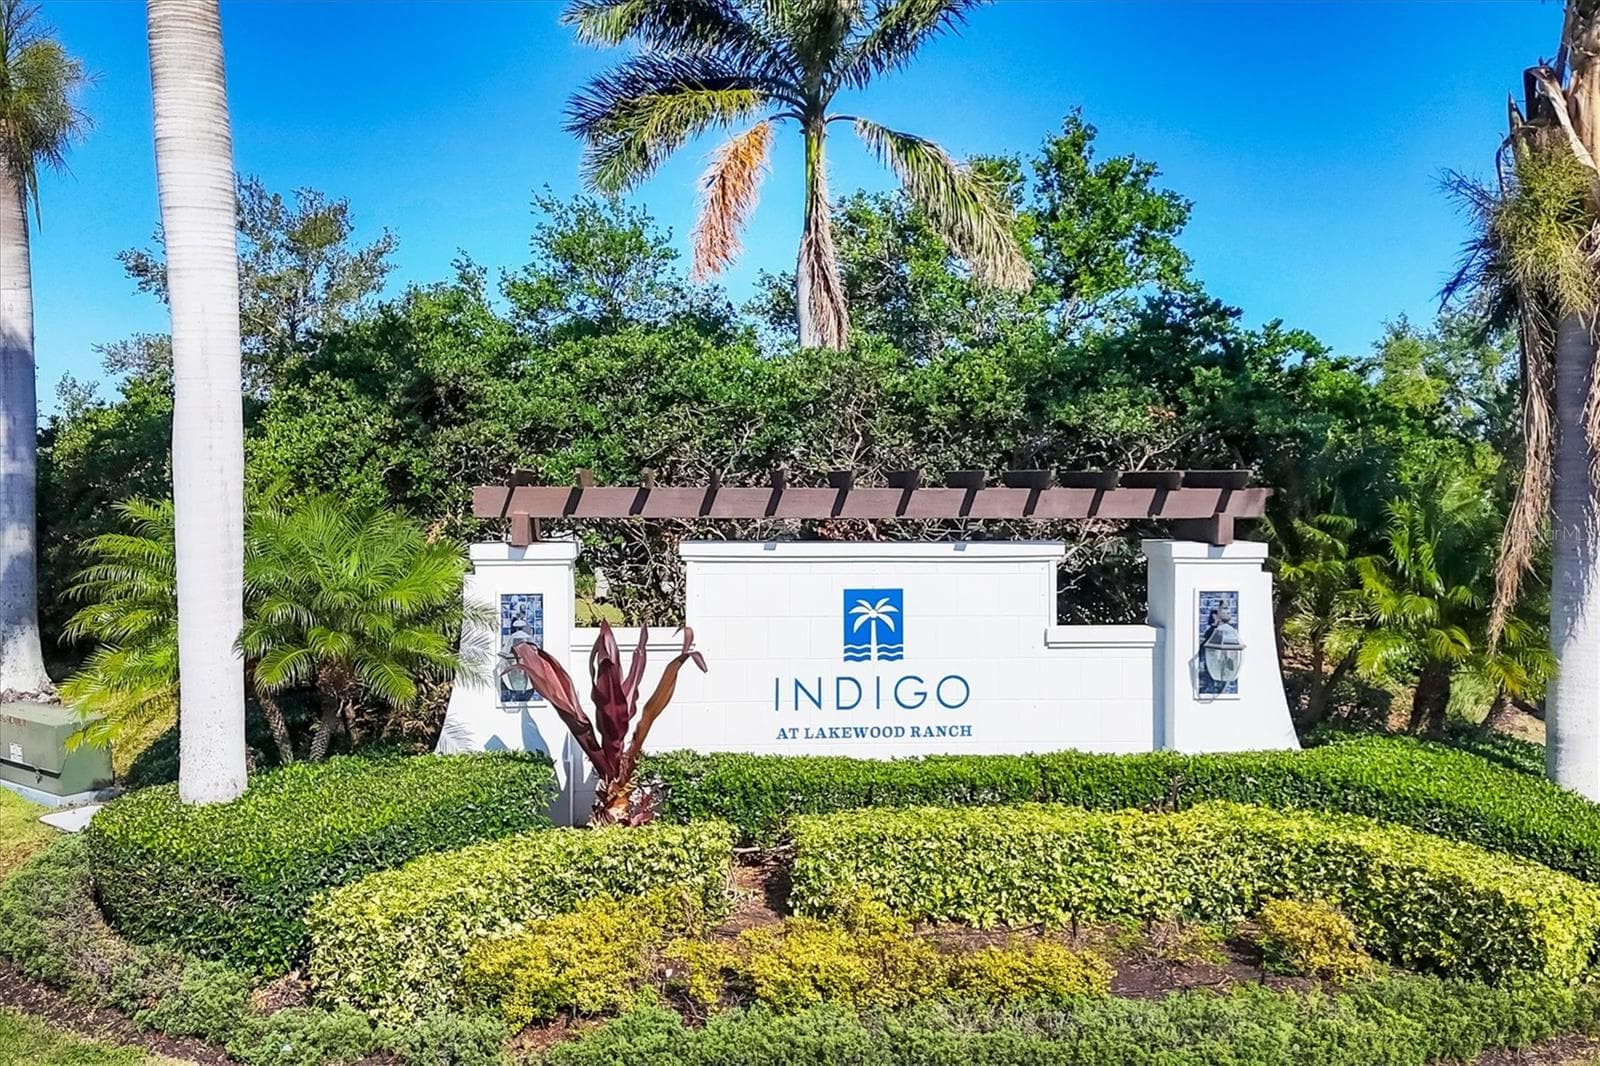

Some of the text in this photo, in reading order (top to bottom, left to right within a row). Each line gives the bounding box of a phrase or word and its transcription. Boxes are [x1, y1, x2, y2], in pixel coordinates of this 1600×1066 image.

[775, 675, 970, 711] INDIGO
[776, 725, 973, 740] AT LAKEWOOD RANCH
